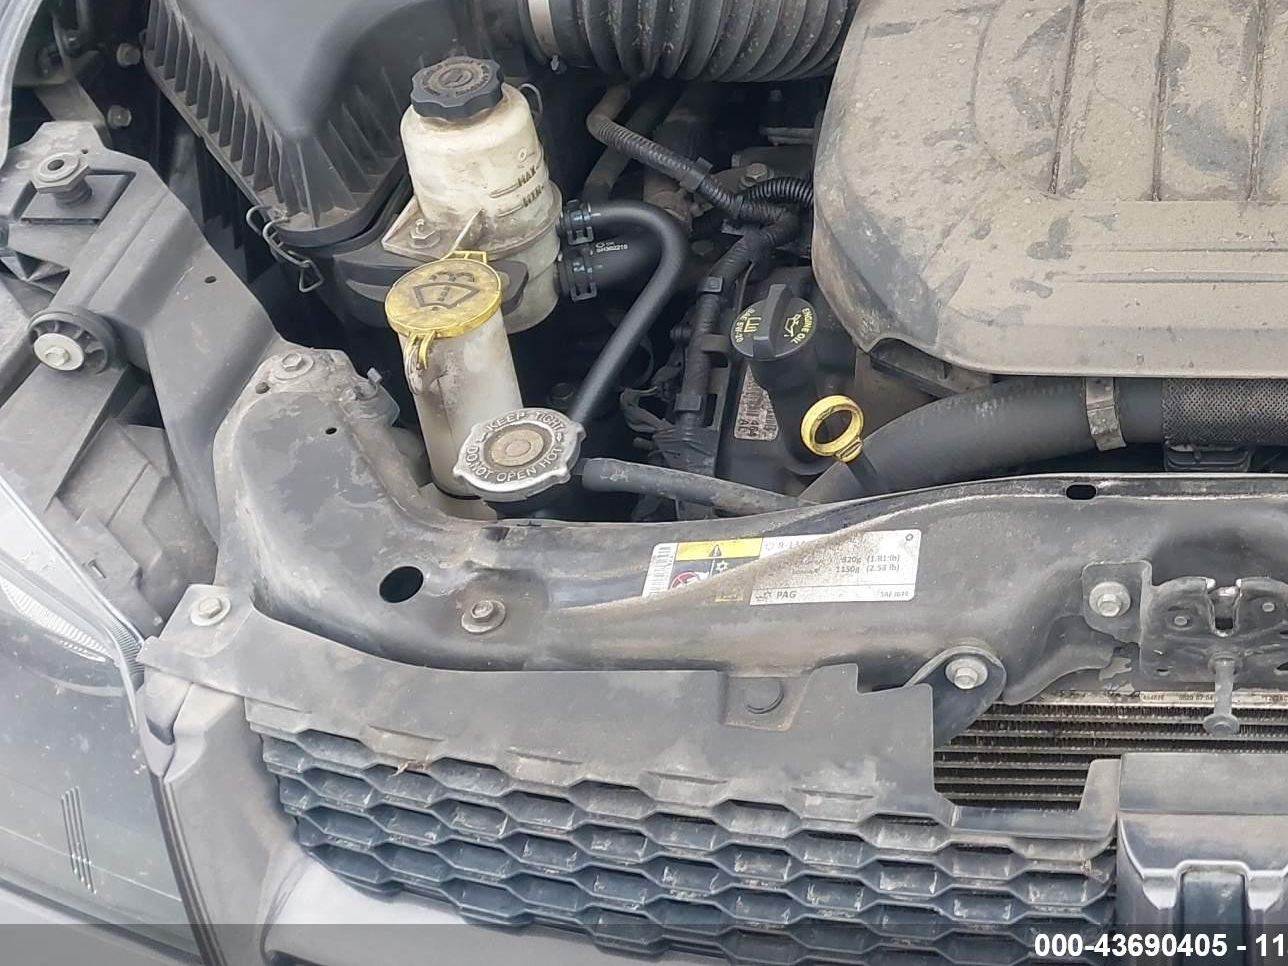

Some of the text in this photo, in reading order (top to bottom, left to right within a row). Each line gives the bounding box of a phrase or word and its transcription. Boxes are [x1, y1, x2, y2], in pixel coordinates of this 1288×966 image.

[518, 165, 536, 187] MAX
[790, 307, 813, 344] ENGINE OIL
[486, 411, 566, 433] KEEP TIGHT
[466, 445, 562, 482] DO NOT OPEN HOT
[776, 590, 797, 599] PAG
